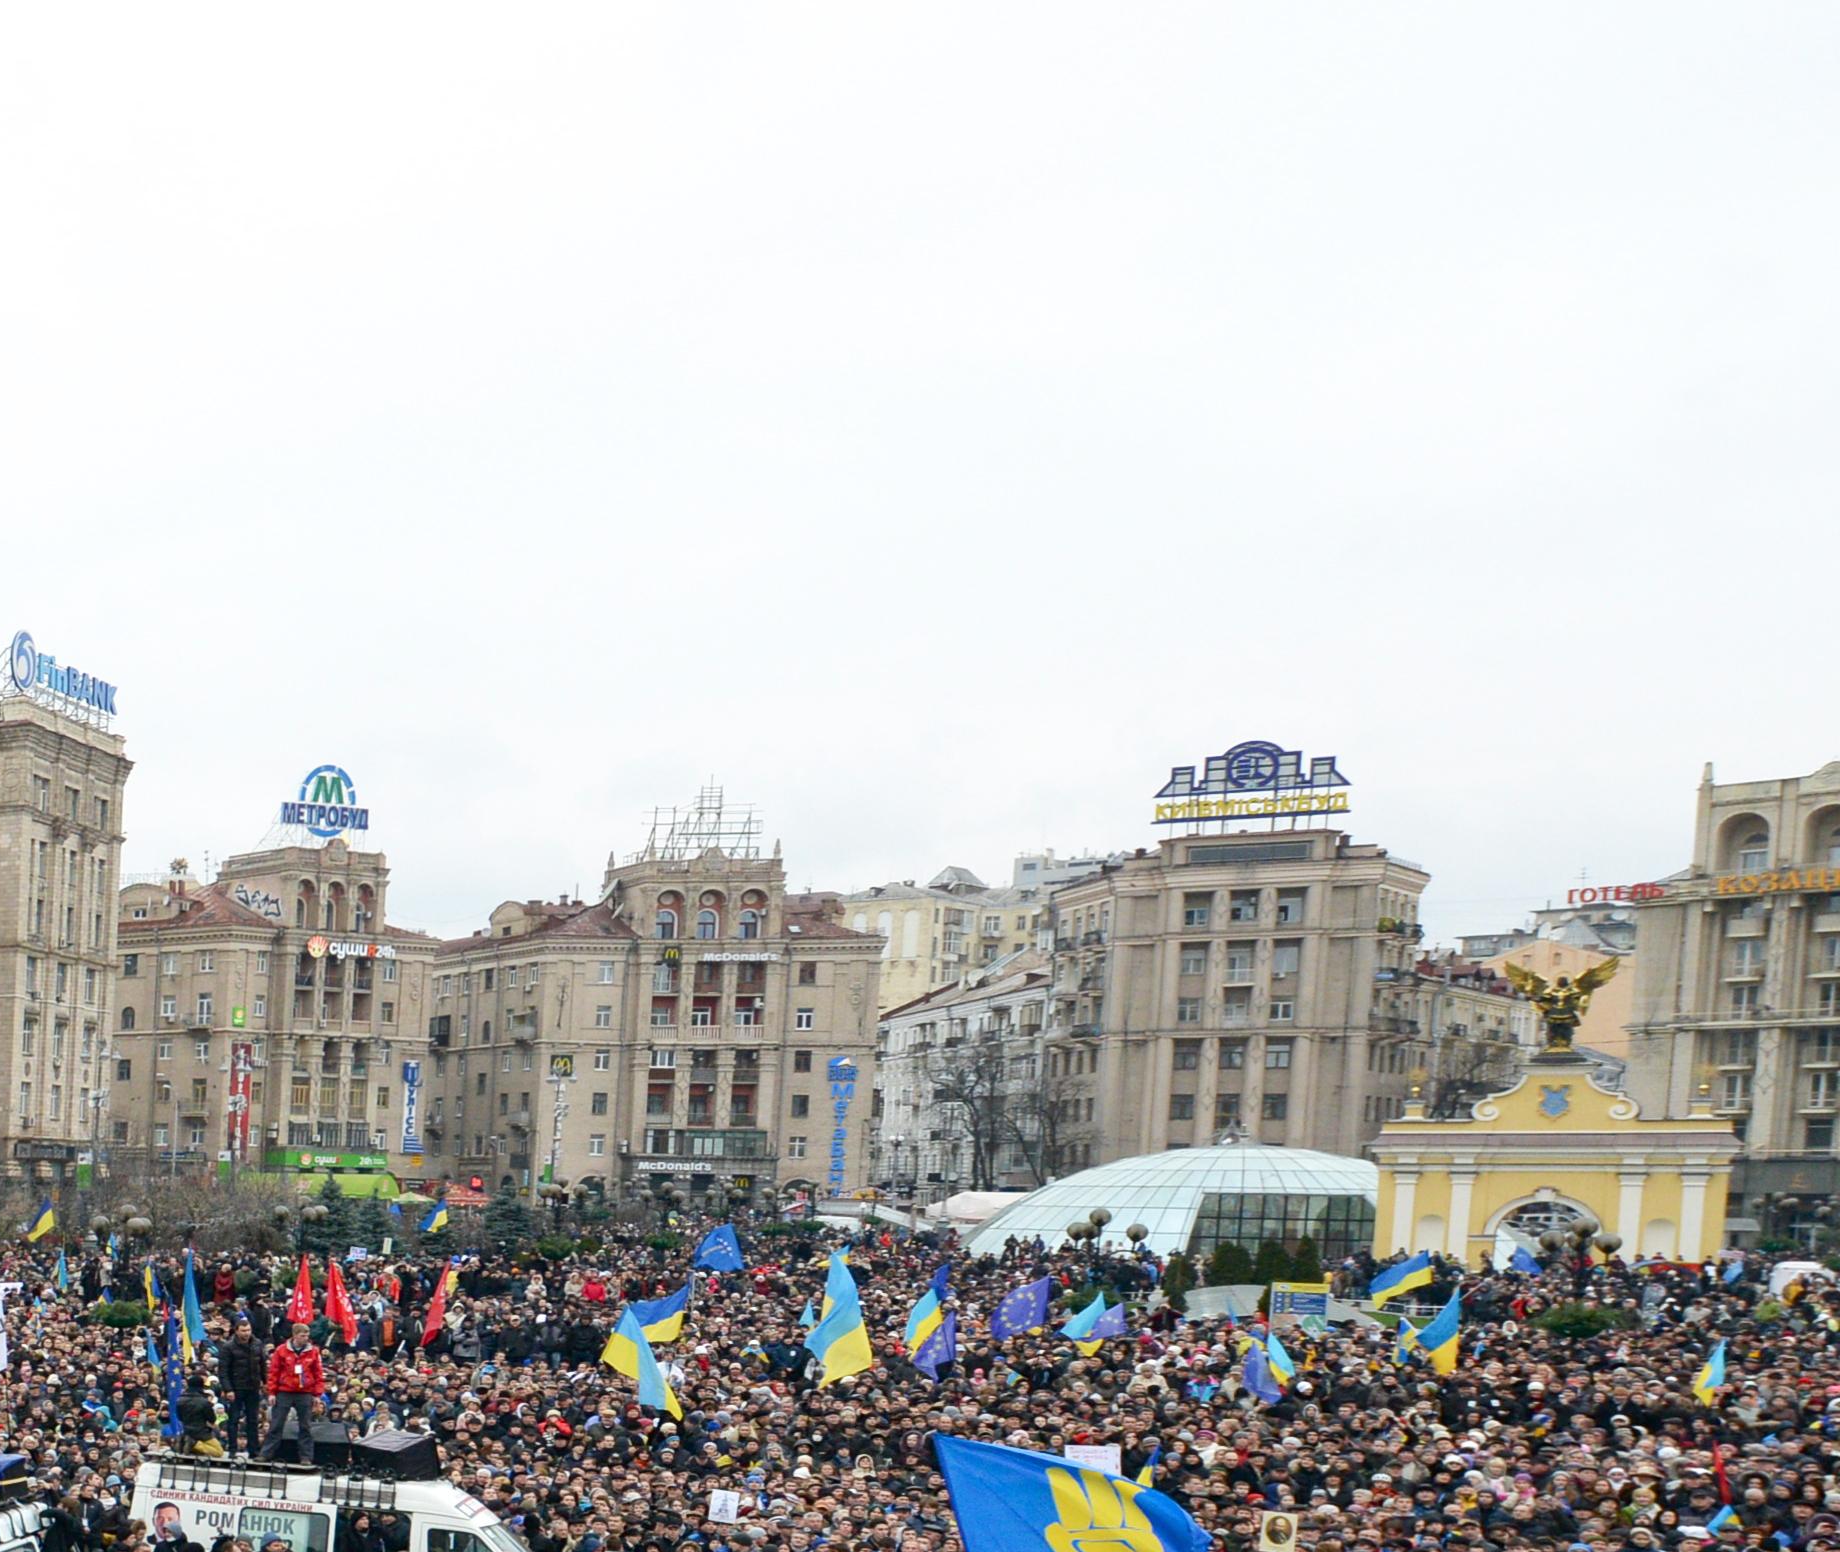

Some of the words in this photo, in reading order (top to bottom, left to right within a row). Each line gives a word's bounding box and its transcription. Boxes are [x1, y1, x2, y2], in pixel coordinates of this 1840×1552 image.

[37, 652, 117, 715] FinBANK
[1155, 792, 1349, 816] КИЇВМІСЬКБУД
[281, 802, 369, 830] МЕТРОБУД
[1567, 883, 1664, 904] ГОТЕЛЬ
[703, 952, 779, 962] McDonald's
[638, 1161, 712, 1171] McDonald's
